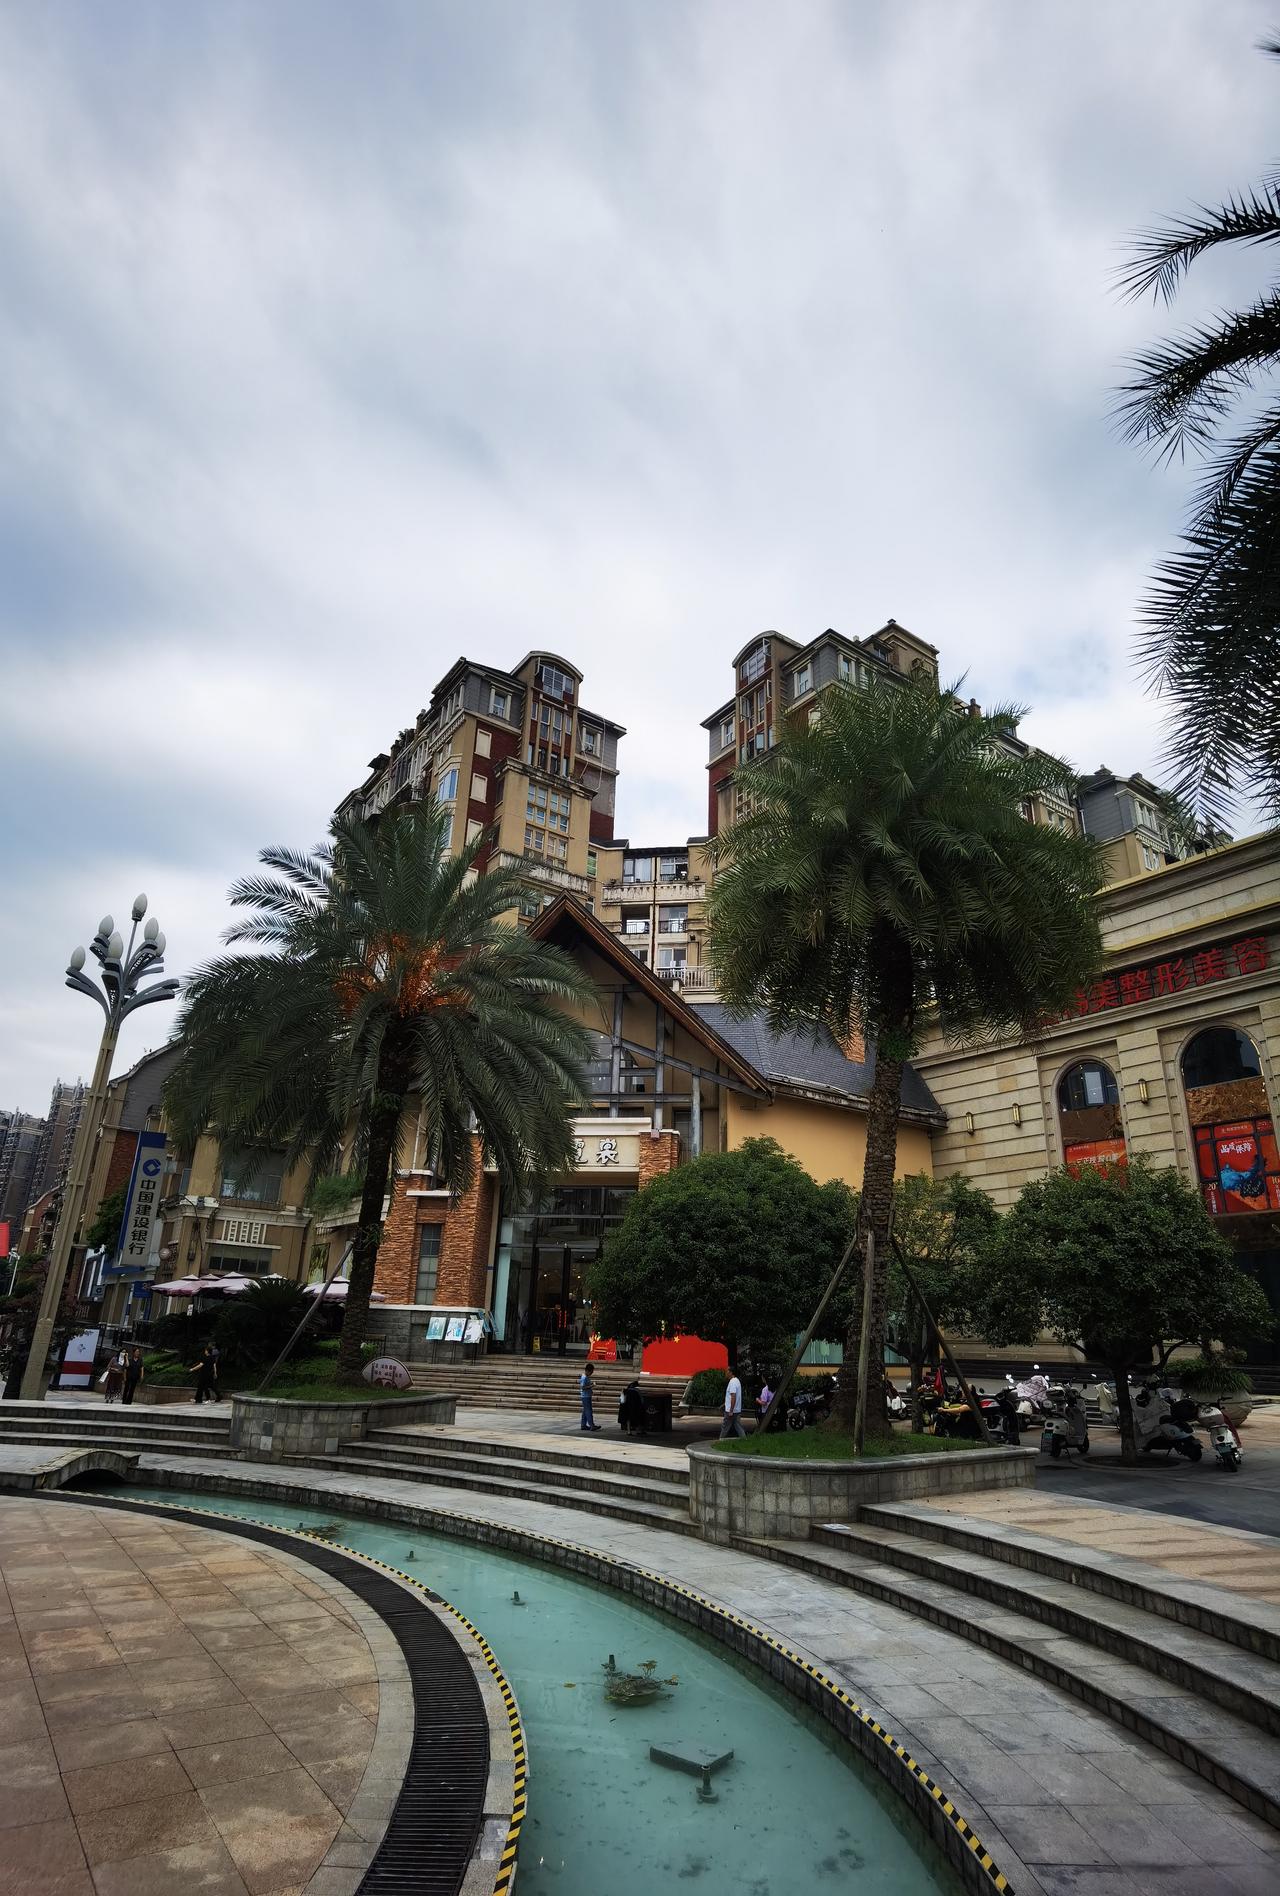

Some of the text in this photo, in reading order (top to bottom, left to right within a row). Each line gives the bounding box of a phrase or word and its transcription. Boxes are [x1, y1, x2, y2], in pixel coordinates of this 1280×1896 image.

[1041, 936, 1269, 1025] 美整形美容
[128, 1179, 156, 1256] 中国建设银行
